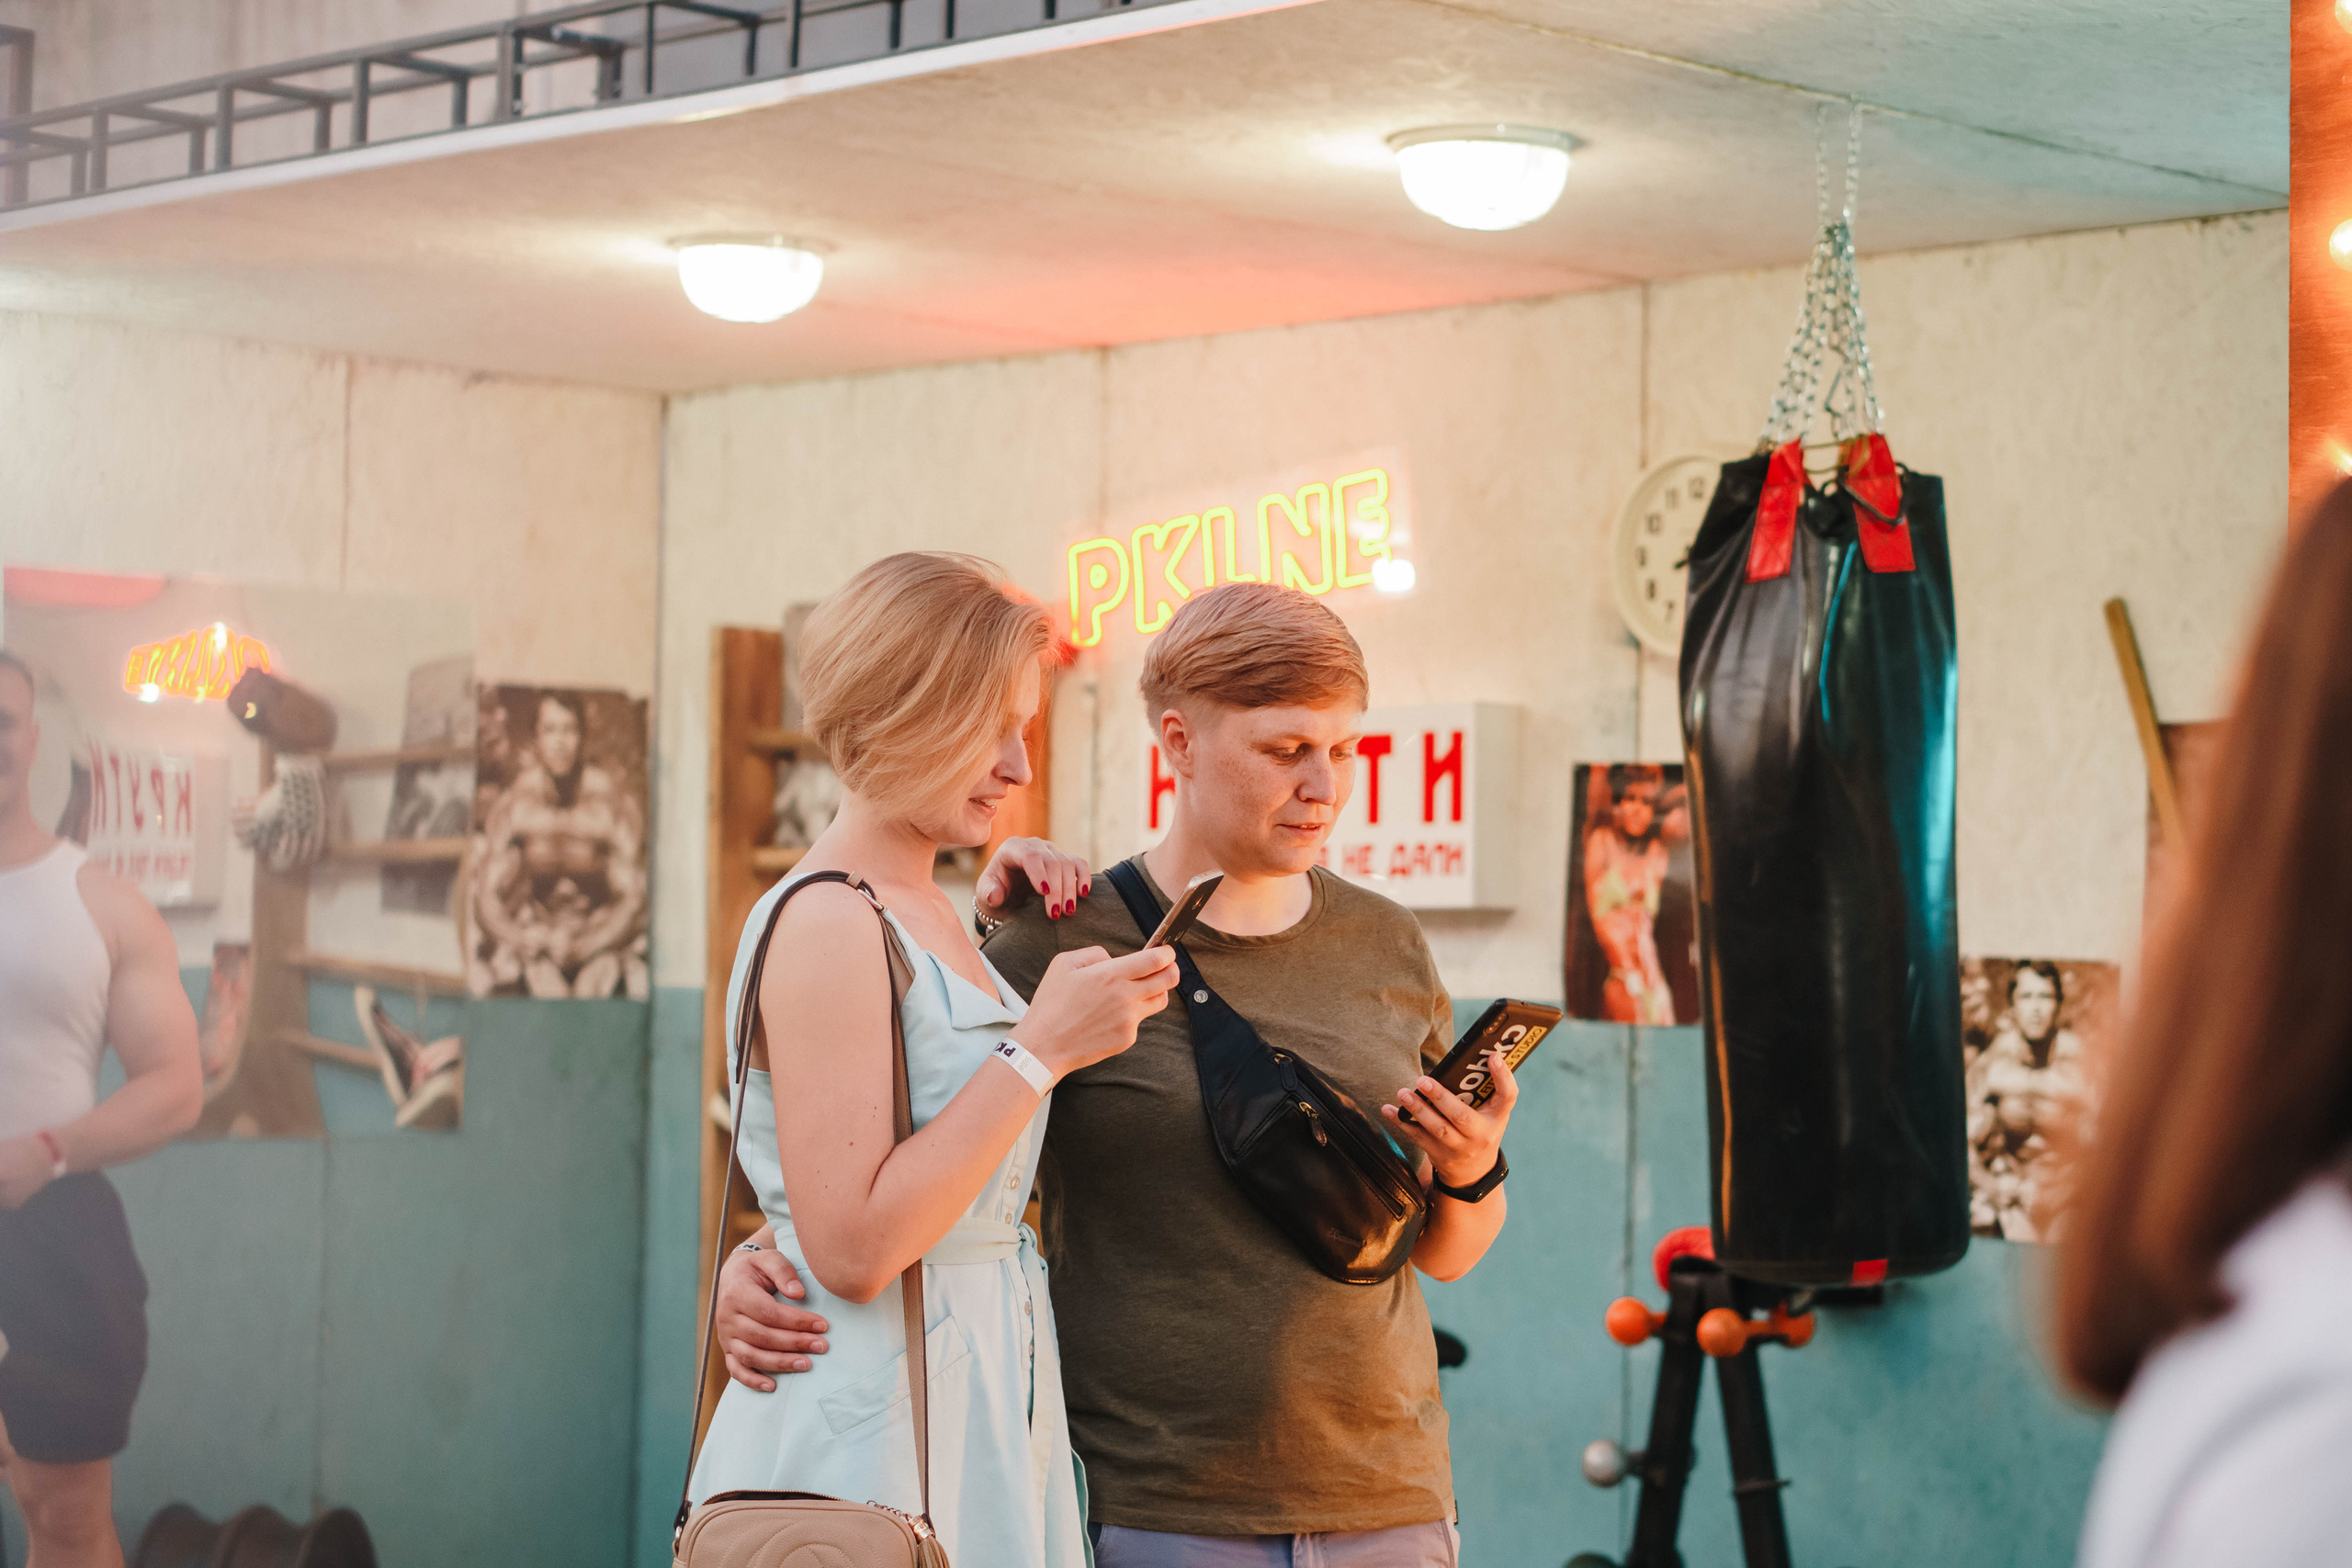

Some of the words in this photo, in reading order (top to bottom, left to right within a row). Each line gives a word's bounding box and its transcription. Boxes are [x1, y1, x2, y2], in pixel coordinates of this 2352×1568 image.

[1665, 488, 1680, 509] 11
[1689, 477, 1704, 499] 12
[1645, 514, 1662, 536] 10
[1067, 467, 1393, 647] PKLNE
[1149, 731, 1464, 829] КТИ
[1510, 1027, 1544, 1059] STUDIO
